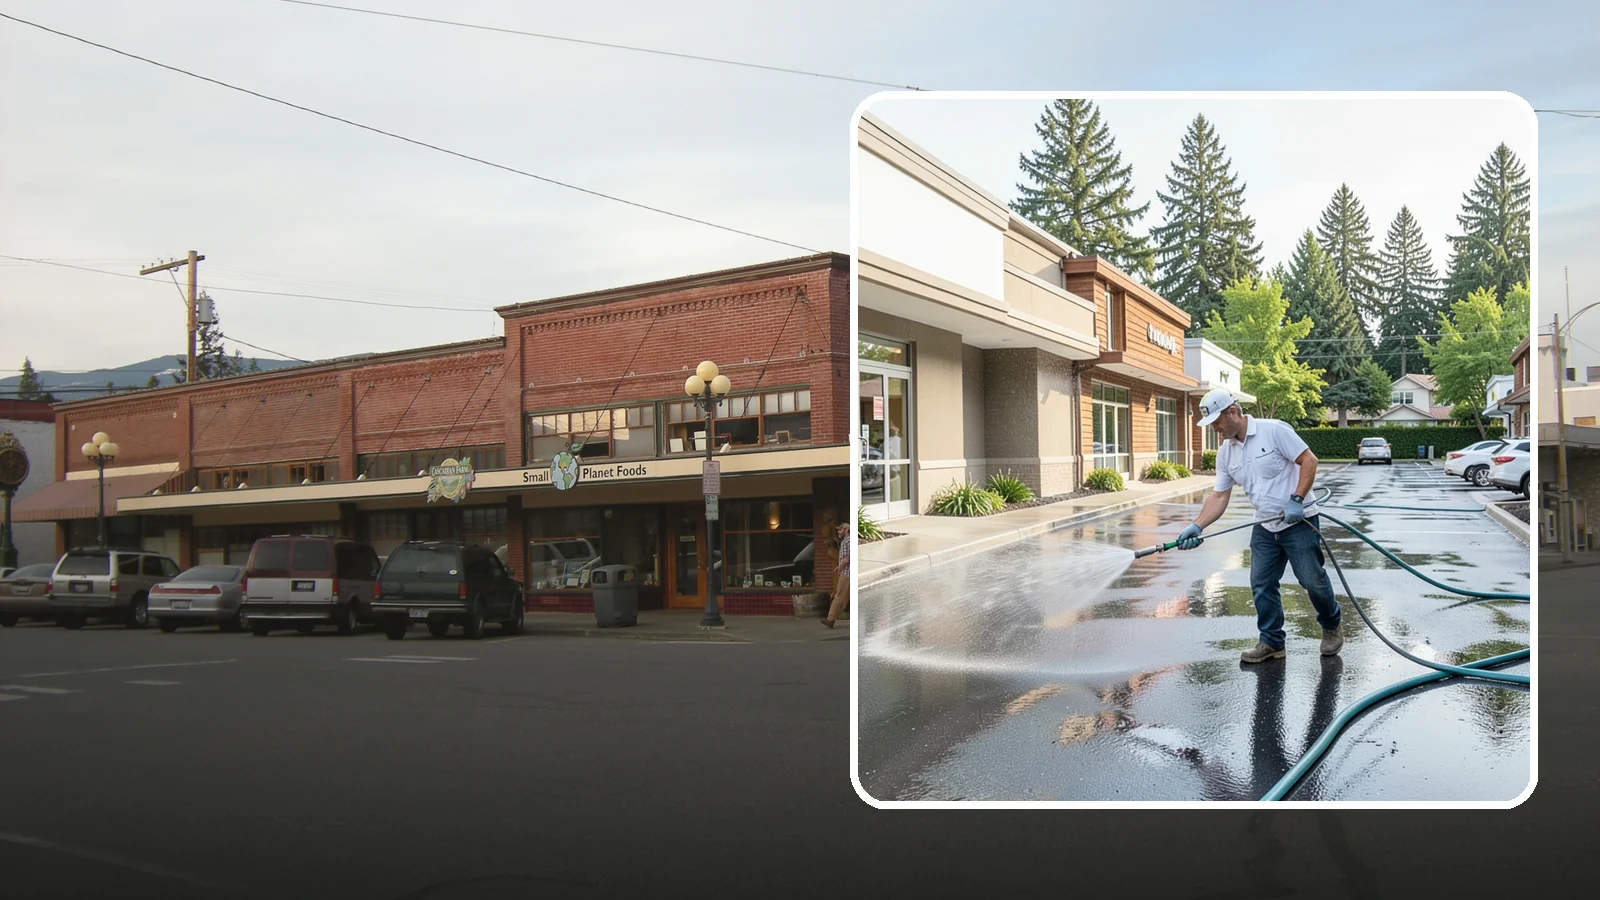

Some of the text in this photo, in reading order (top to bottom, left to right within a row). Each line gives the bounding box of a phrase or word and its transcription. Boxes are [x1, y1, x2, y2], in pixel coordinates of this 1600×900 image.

[523, 465, 647, 483] Small Planet Foods
